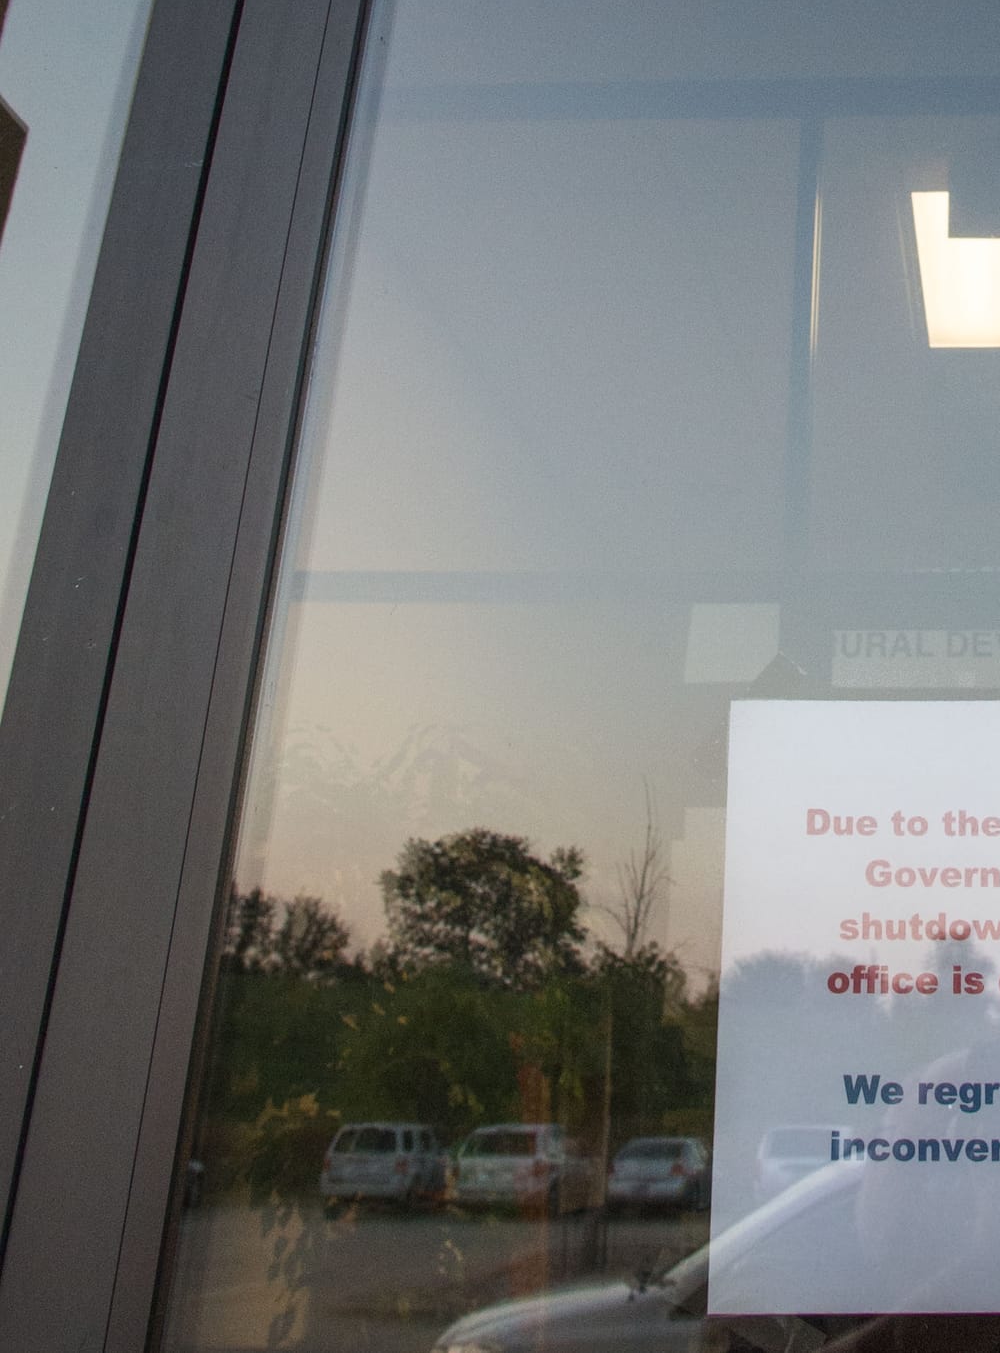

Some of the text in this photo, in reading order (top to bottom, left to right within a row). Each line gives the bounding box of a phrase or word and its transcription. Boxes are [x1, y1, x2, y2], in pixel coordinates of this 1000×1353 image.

[806, 808, 878, 836] Due
[891, 810, 928, 836] to
[827, 965, 938, 995] office
[952, 965, 985, 994] is
[843, 1074, 904, 1105] We
